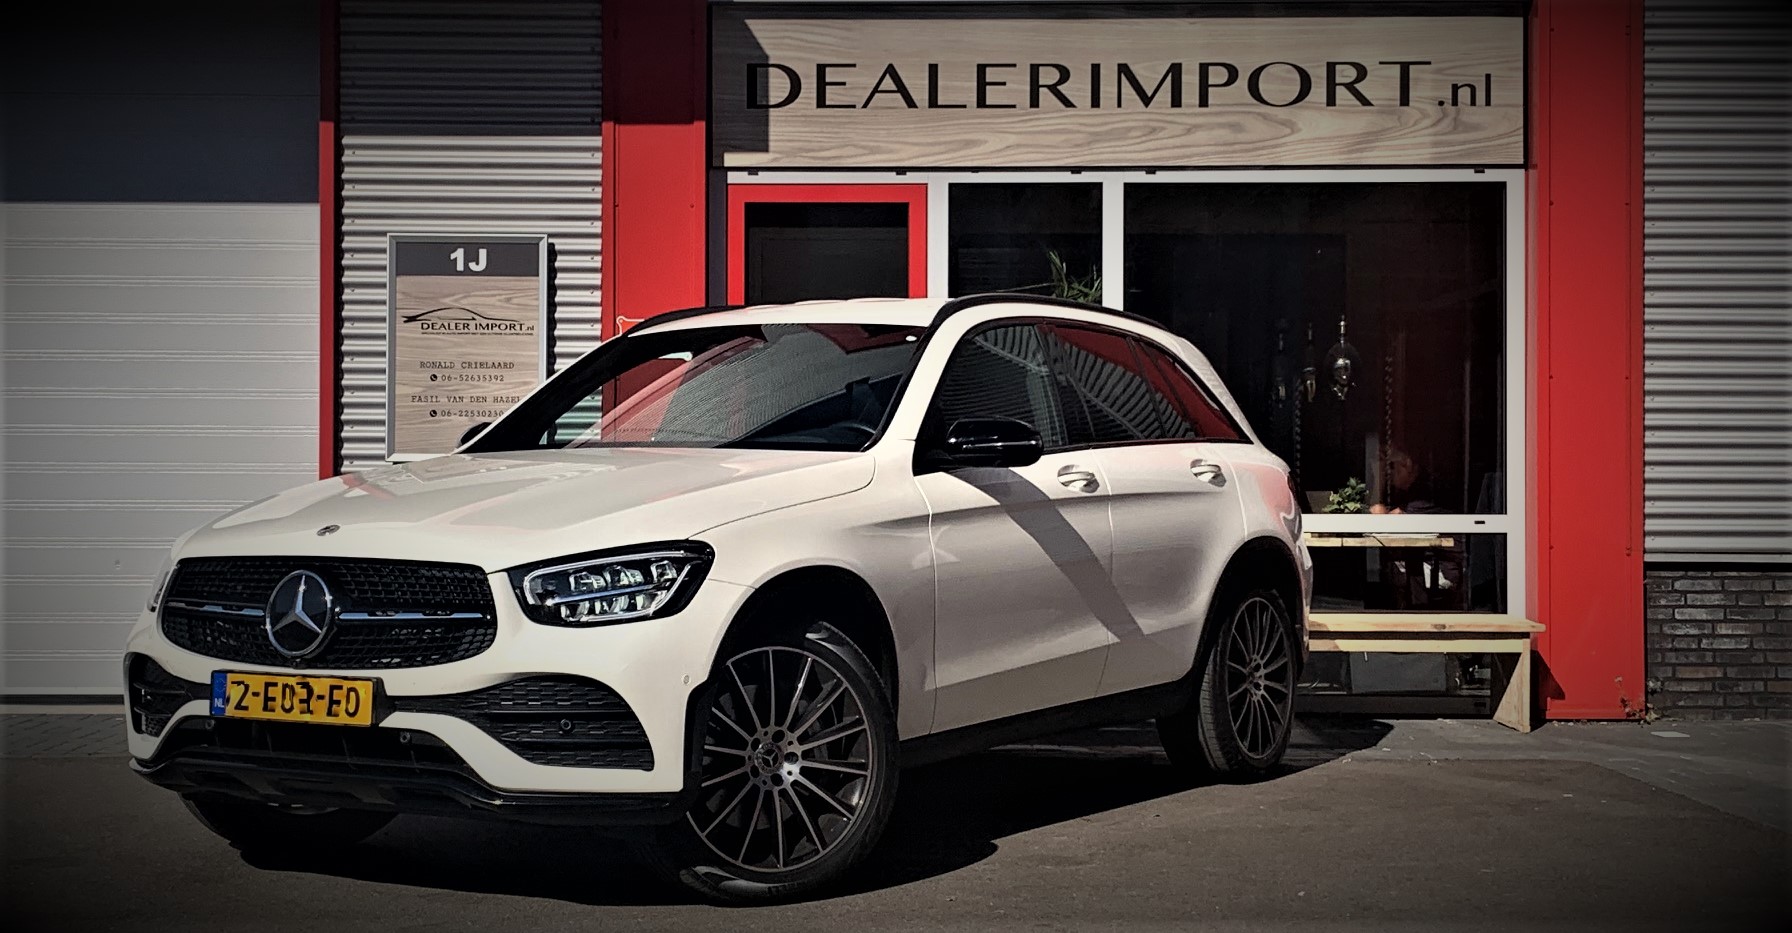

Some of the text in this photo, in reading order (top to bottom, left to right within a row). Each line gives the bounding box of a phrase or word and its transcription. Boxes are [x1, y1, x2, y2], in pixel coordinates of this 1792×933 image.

[745, 60, 1493, 111] DEALERIMPORT.nl
[450, 248, 488, 272] 1J
[420, 322, 535, 331] DEALER IMPORT.nl
[420, 361, 515, 369] RONALD CRIELAARD
[441, 374, 505, 382] 06-52635392
[469, 395, 487, 403] DEN
[214, 699, 225, 708] NL
